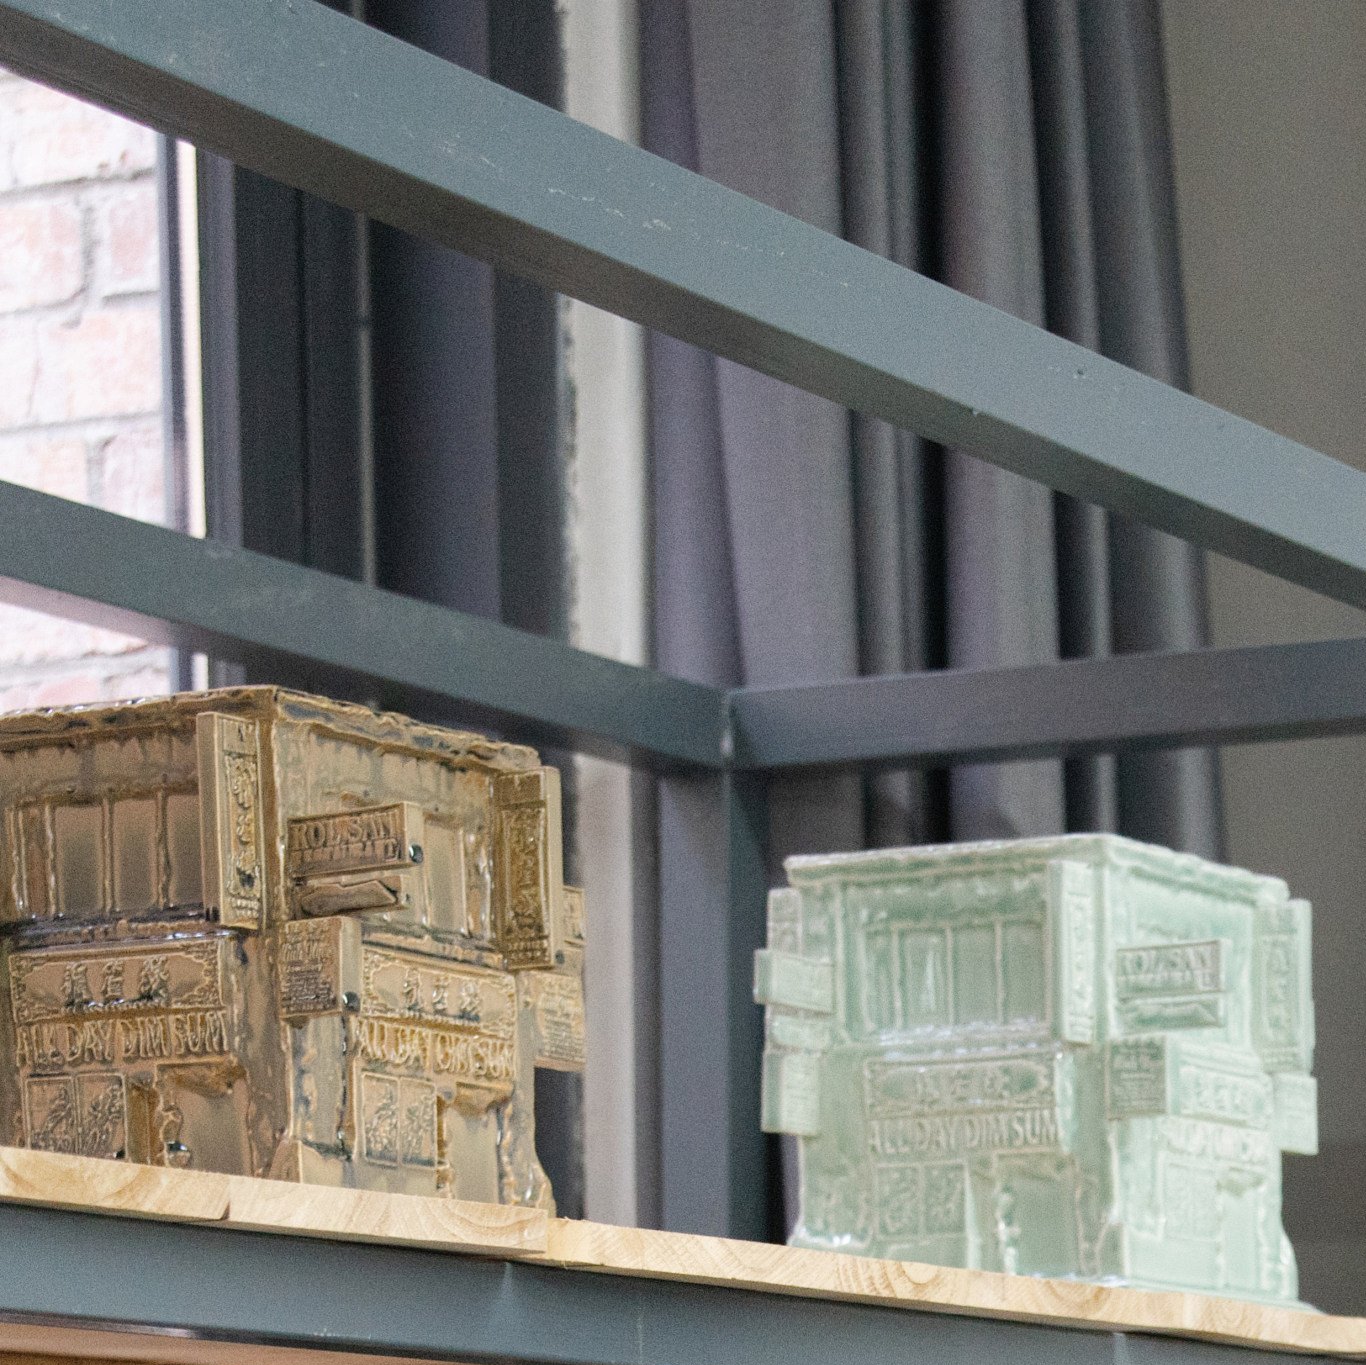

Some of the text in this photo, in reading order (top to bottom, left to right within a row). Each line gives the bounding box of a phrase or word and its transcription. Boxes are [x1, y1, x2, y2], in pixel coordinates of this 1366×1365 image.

[65, 1019, 116, 1064] DAY
[119, 1015, 171, 1060] DIM
[173, 1009, 229, 1057] SUM
[1011, 1108, 1060, 1147] SUM
